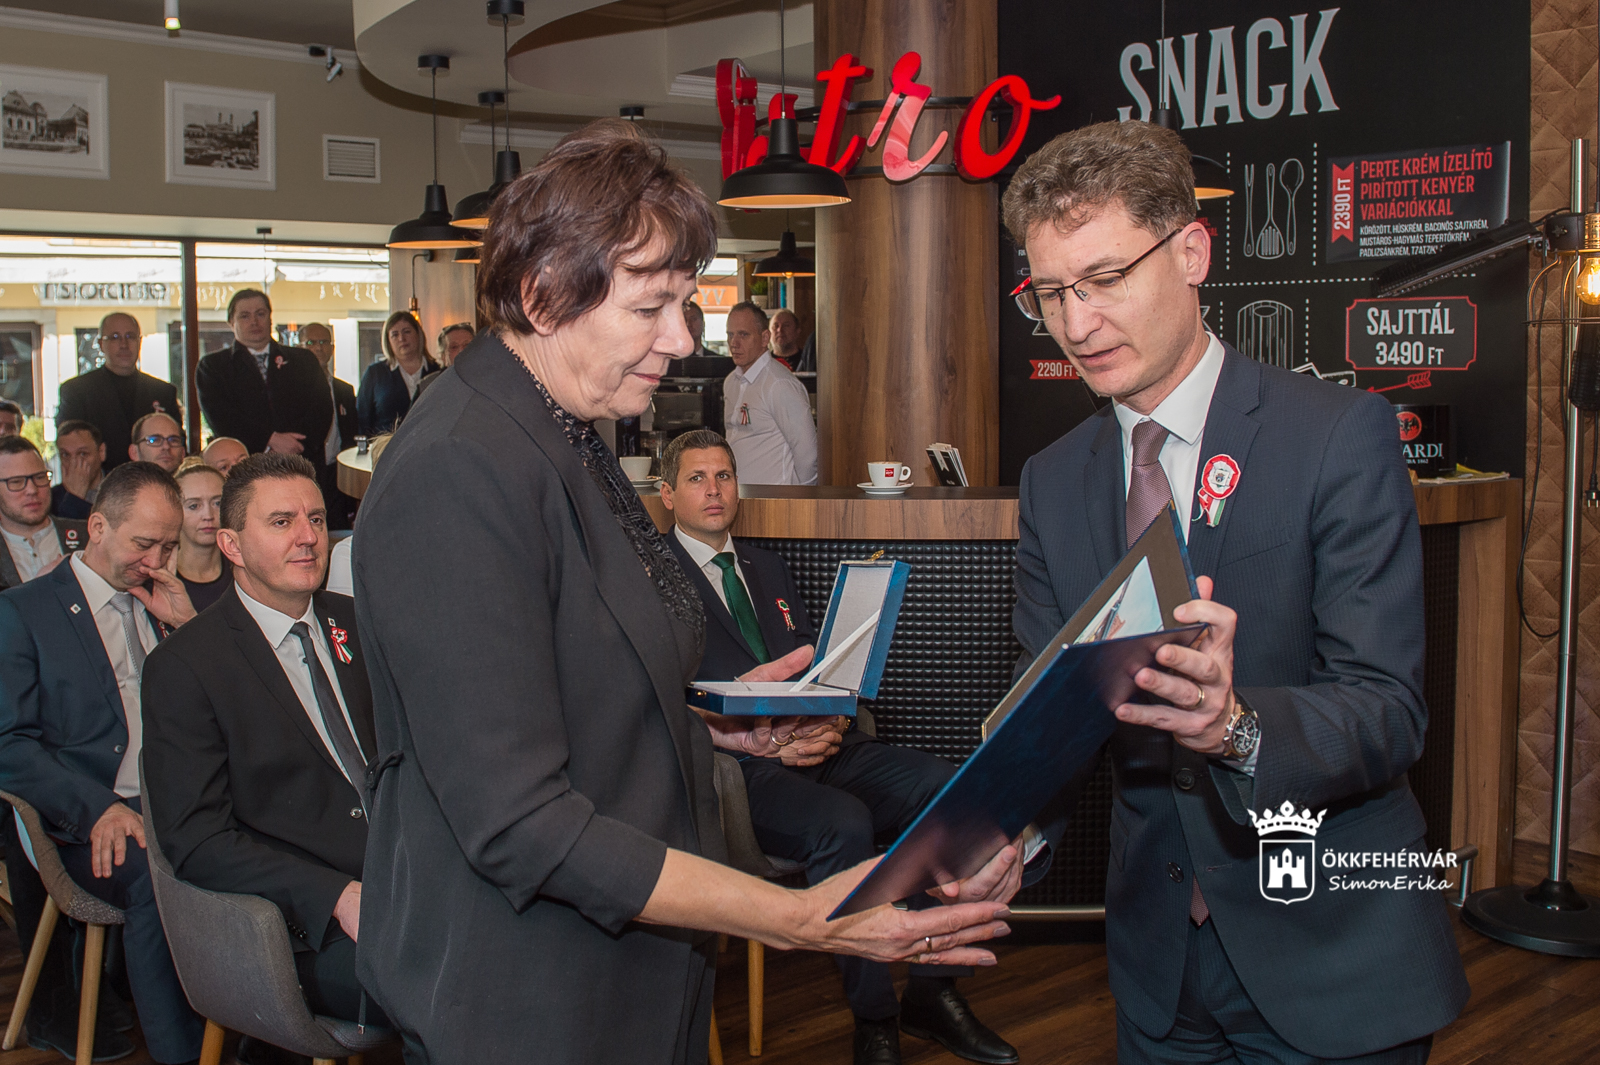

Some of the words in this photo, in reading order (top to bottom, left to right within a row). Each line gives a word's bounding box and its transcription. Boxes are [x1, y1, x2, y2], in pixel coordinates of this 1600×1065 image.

[1117, 8, 1340, 129] SNACK
[1361, 160, 1399, 179] PERTE
[1402, 153, 1440, 176] KRÉM
[1443, 147, 1493, 173] ÍZELÍTŐ
[1337, 178, 1351, 191] FT
[1360, 178, 1417, 200] PIRÍTOTT
[1421, 172, 1475, 196] KENYÉR
[1334, 193, 1351, 230] 2390
[1360, 197, 1454, 220] VARIÁCIÓKKAL
[1454, 218, 1489, 231] SAJTKRÉM,
[1359, 234, 1424, 246] MUSTÁROS-HAGYMÁS
[1367, 302, 1455, 336] SAJTTÁL
[1375, 341, 1424, 365] 3490
[1428, 347, 1444, 365] FT
[1037, 362, 1062, 377] 2290
[1064, 365, 1073, 377] FT
[1402, 443, 1443, 458] ARDI
